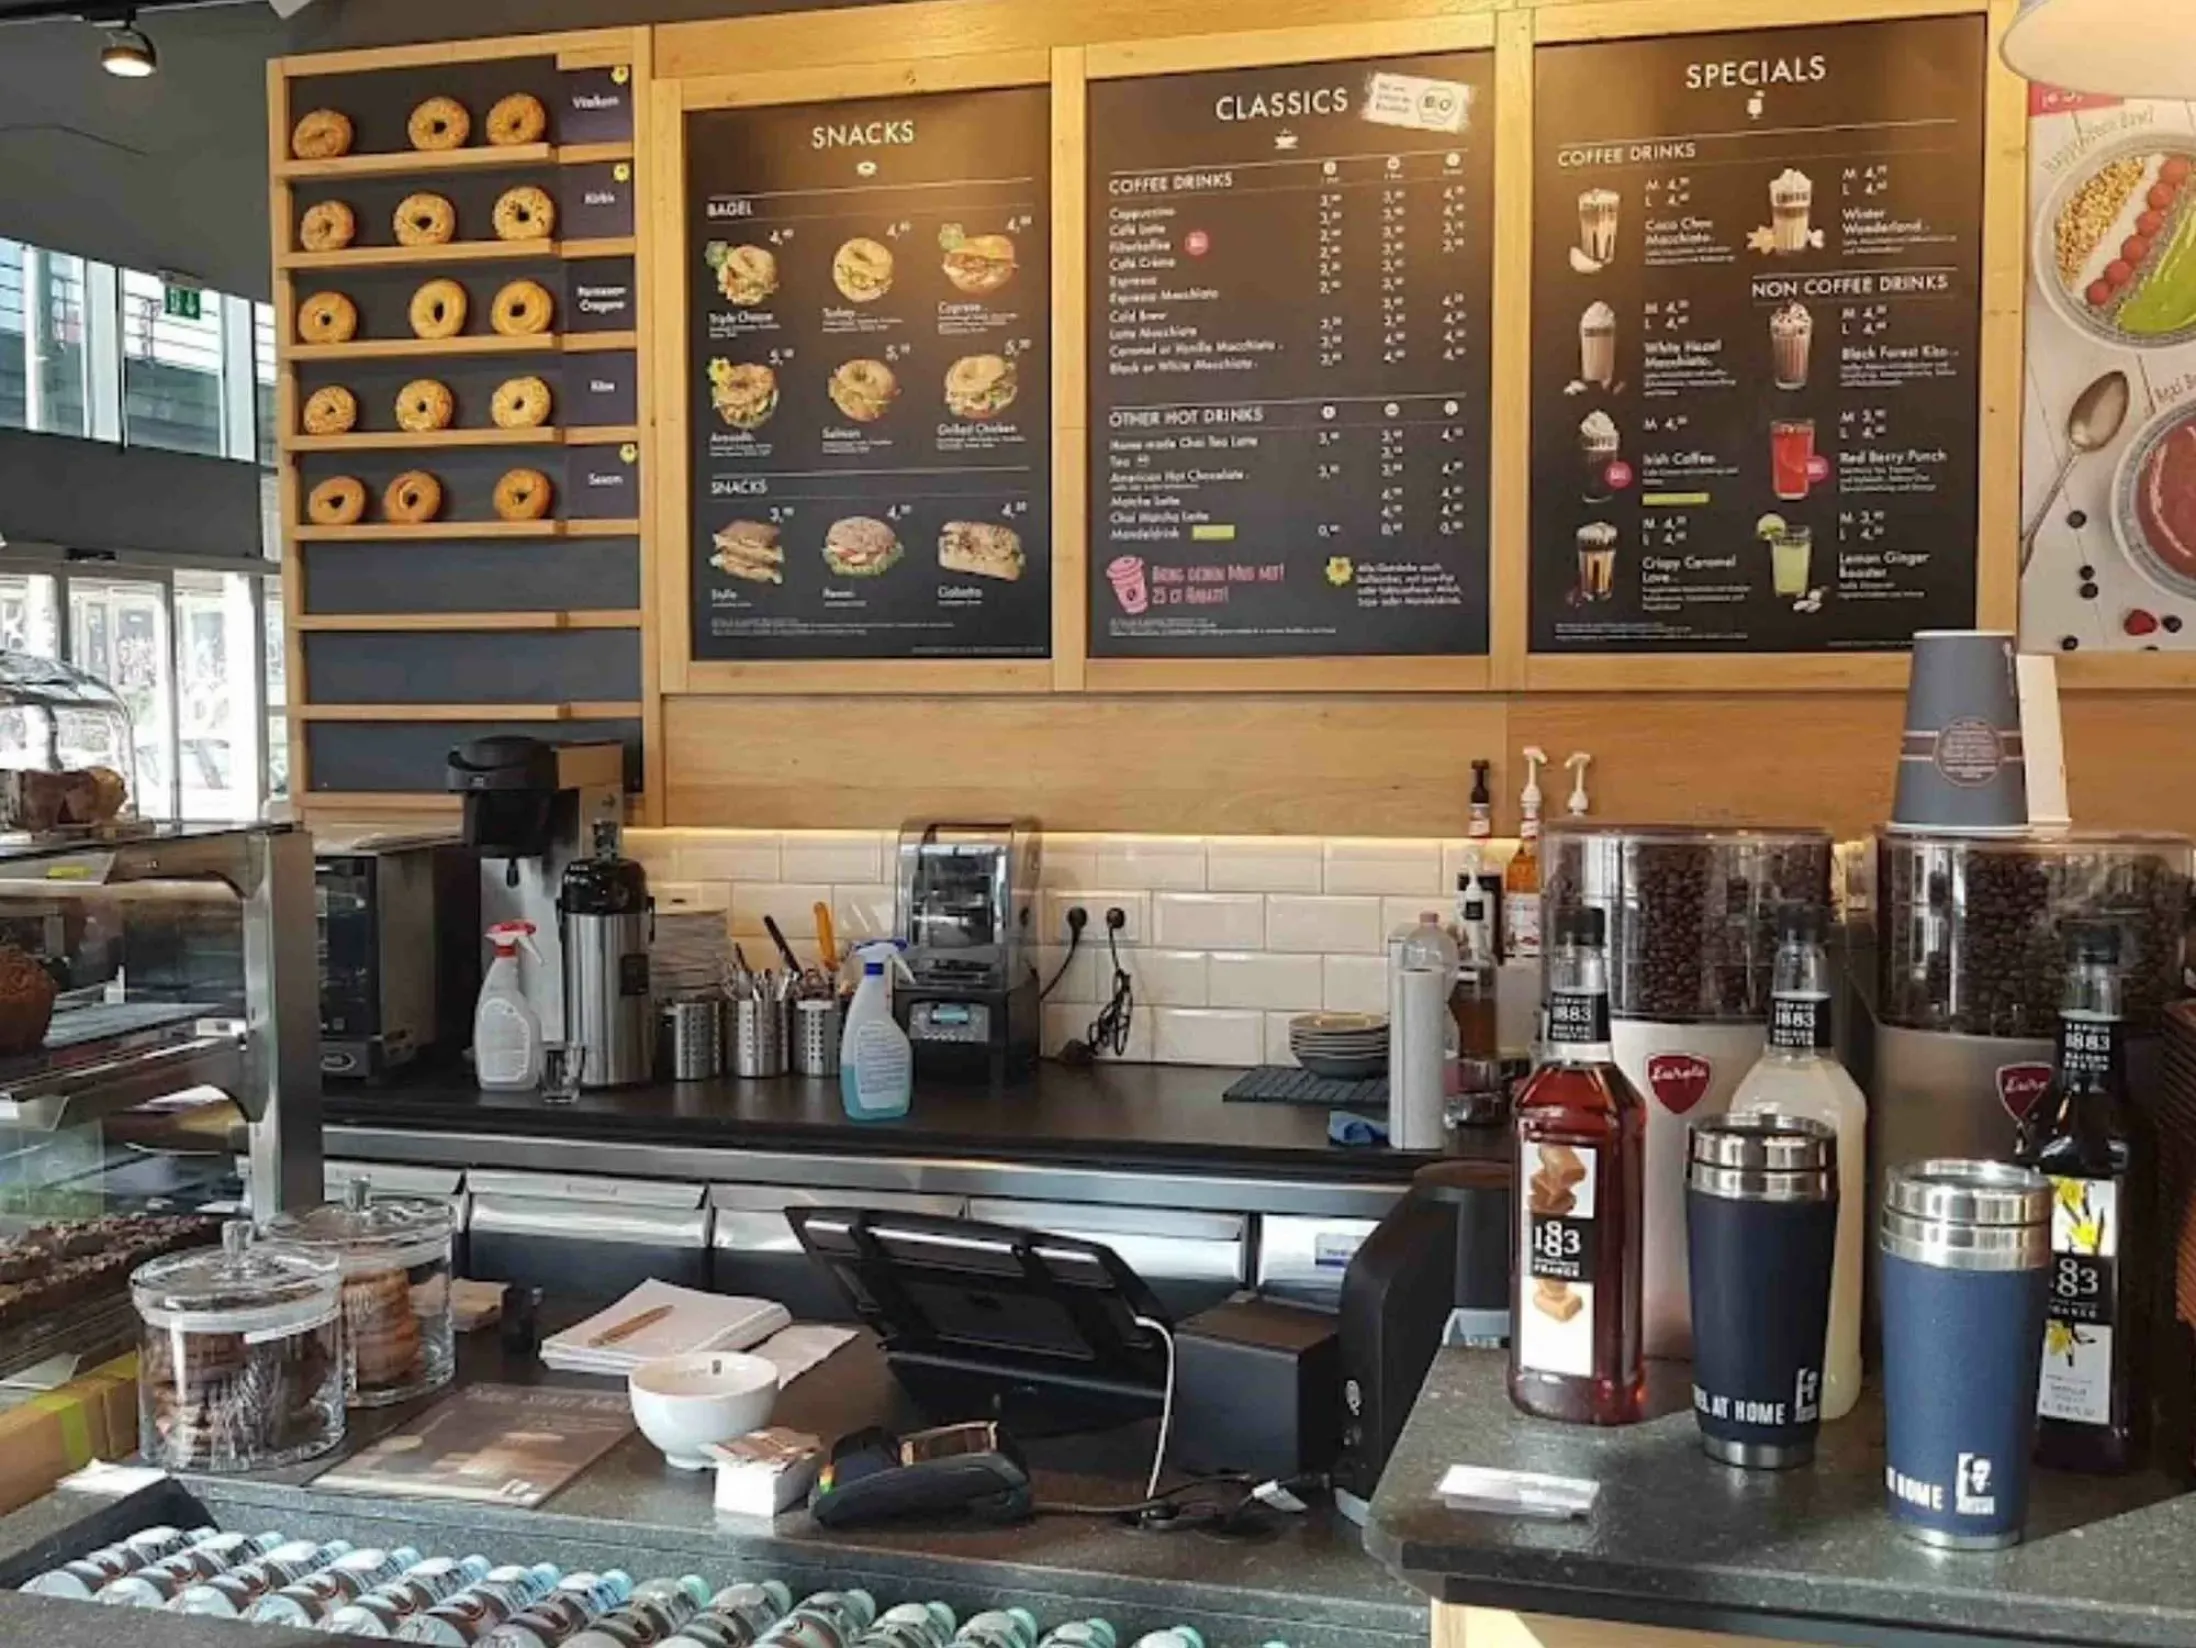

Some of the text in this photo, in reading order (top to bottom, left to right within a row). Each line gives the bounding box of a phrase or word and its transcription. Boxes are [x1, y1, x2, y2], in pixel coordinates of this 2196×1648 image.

[1685, 54, 1828, 91] SPECIALS
[1215, 86, 1349, 121] CLASSICS
[811, 119, 916, 150] SNACKS
[1558, 141, 1696, 168] COFFEE DRINKS
[1109, 171, 1233, 194] COFFEE DRINKS
[707, 201, 753, 217] BAGEL
[1752, 275, 1948, 298] NON COFFEE DRINKS
[1109, 406, 1264, 427] OTHER HOT DRINKS
[1110, 455, 1131, 468] Tea
[1839, 447, 1948, 465] Red Berry Punch
[711, 478, 769, 495] SNACKS
[1775, 1011, 1815, 1028] 1883
[2065, 1032, 2110, 1051] 1883
[1534, 1220, 1581, 1257] 1883
[1711, 1394, 1730, 1419] AT
[1734, 1399, 1786, 1425] HOME
[1897, 1472, 1944, 1510] HOME
